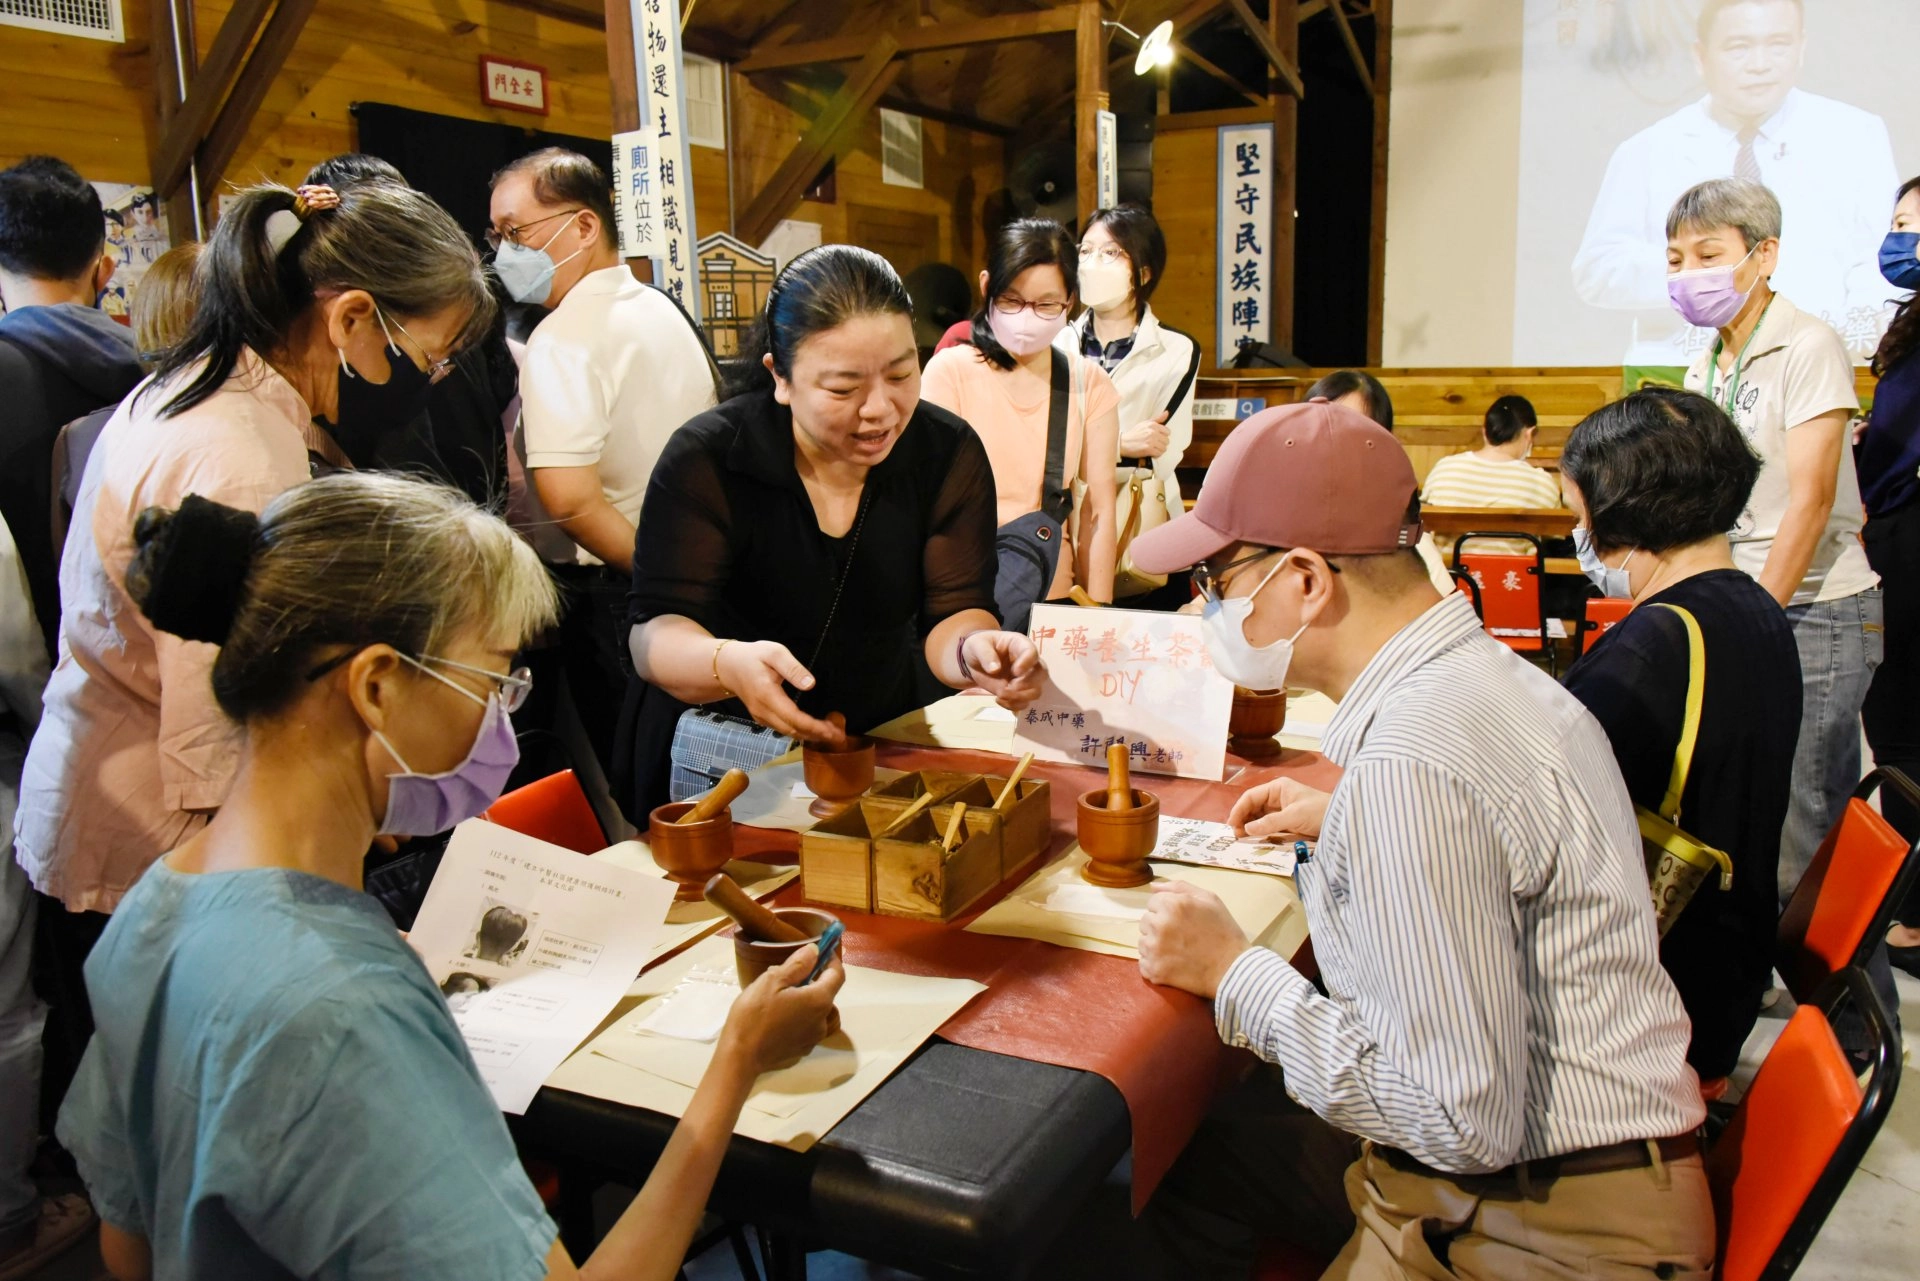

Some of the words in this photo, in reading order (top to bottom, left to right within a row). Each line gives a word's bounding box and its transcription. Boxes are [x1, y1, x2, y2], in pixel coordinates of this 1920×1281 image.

[630, 145, 653, 243] 廁所位於
[1100, 669, 1144, 704] DIY
[1025, 708, 1085, 729] 泰成中藥
